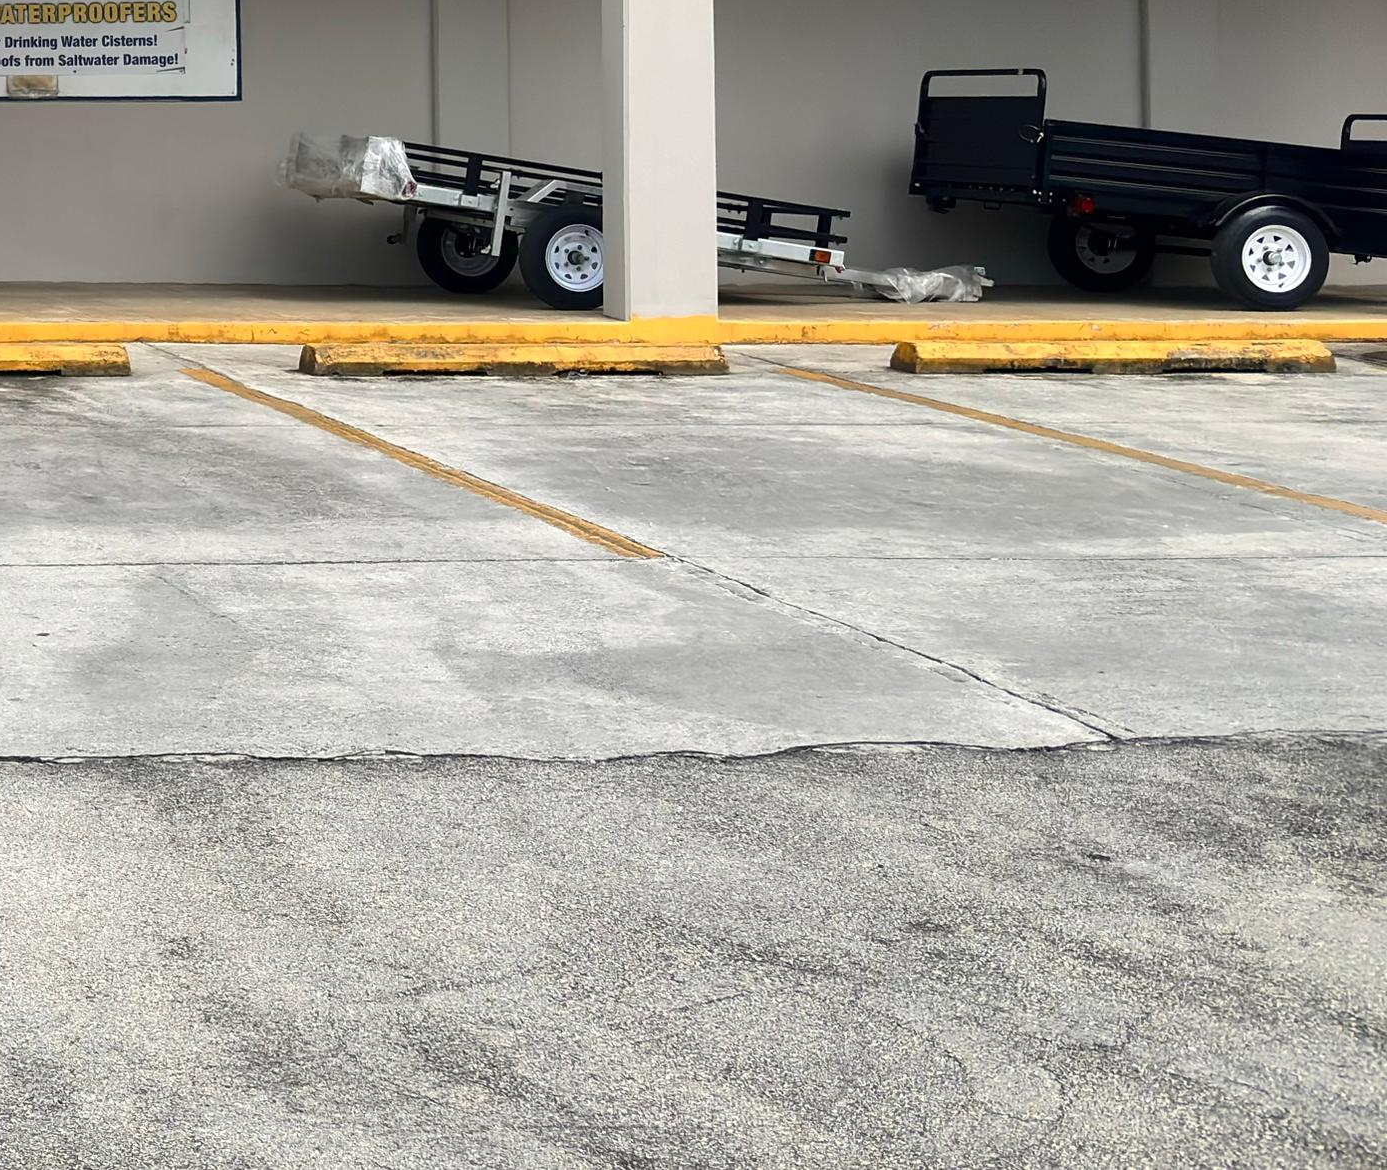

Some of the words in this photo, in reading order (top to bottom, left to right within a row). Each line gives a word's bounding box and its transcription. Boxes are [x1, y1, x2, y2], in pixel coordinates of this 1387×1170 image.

[4, 35, 58, 51] Drinking
[61, 35, 98, 48] Water
[101, 34, 158, 48] Cisterns!
[25, 54, 55, 67] from
[58, 53, 120, 66] Saltwater
[123, 52, 179, 68] Damage!
